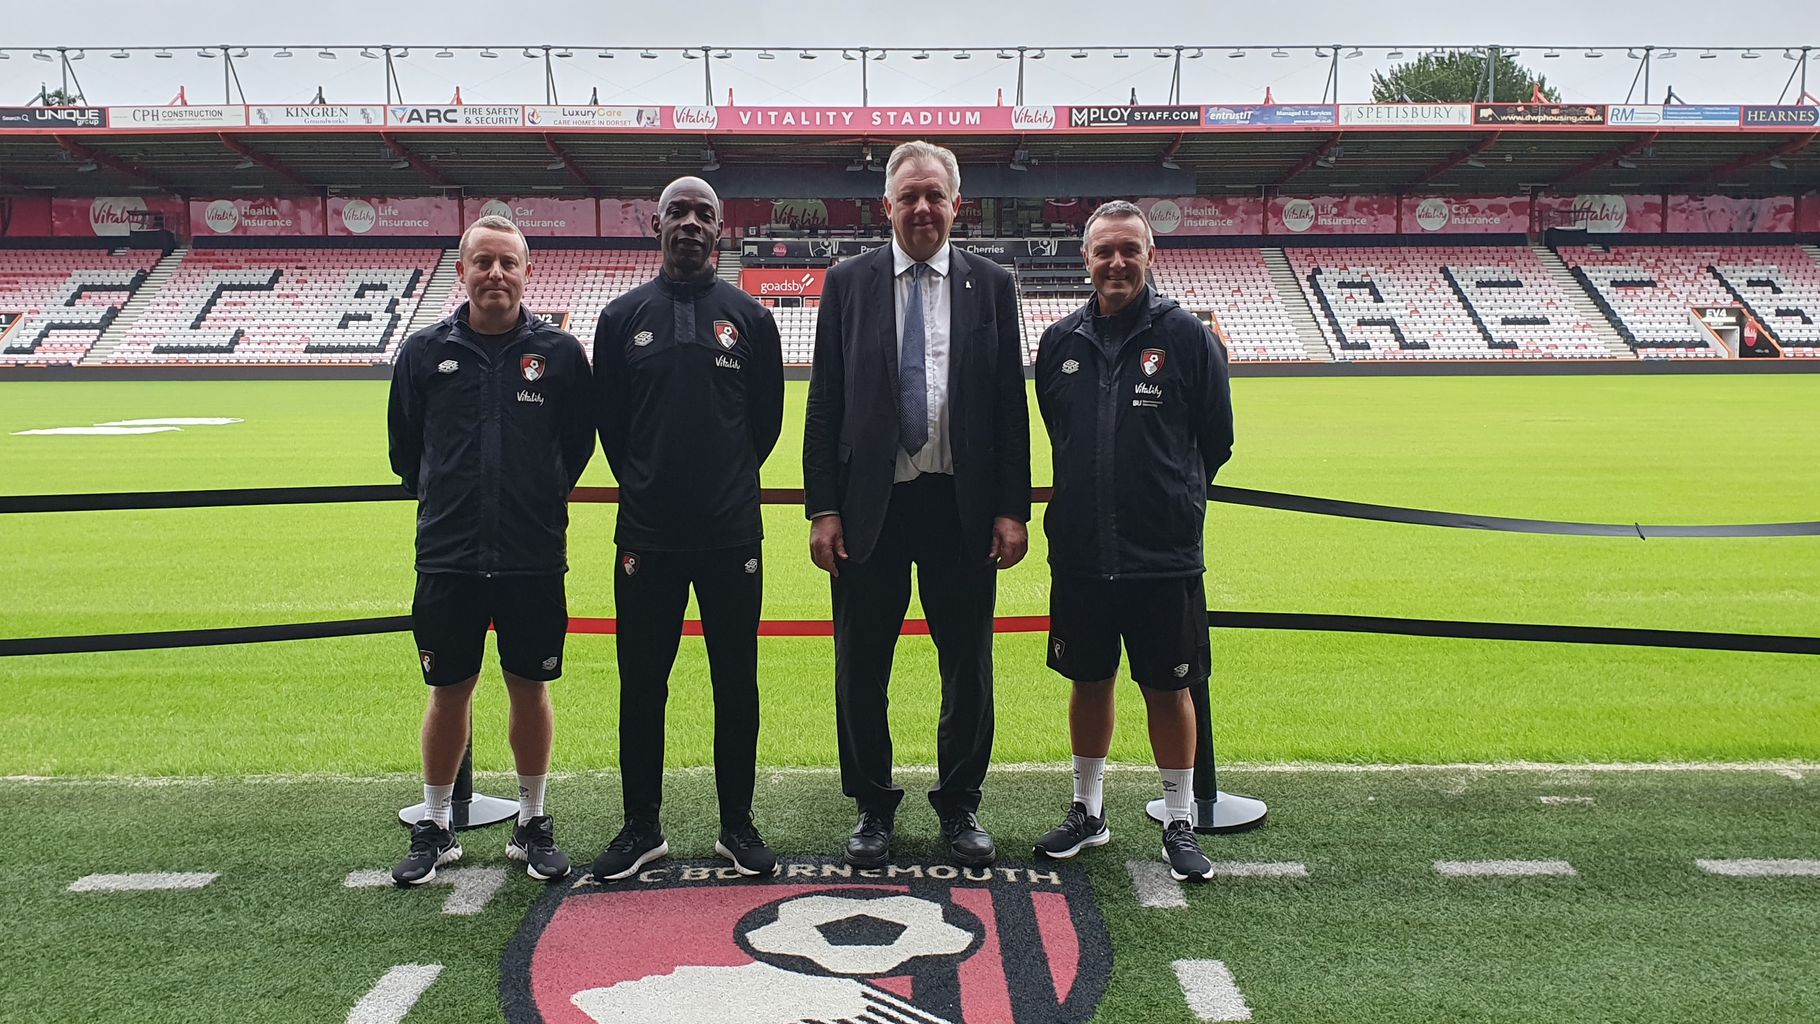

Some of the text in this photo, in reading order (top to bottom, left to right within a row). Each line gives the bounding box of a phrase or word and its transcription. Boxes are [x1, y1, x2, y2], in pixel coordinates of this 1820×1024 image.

[35, 109, 100, 121] UNIQUE
[132, 109, 224, 122] CPH CONSTRUCTION
[285, 106, 349, 118] KINGREN
[406, 108, 458, 124] ARC
[463, 107, 520, 116] FIRE SAFETY
[675, 106, 717, 127] Vitality
[1013, 106, 1054, 126] Vitality
[1134, 111, 1199, 120] STAFF.COM
[1357, 106, 1453, 119] SPETISBURY
[1610, 107, 1635, 121] RM
[1747, 110, 1815, 122] HEARNES
[475, 116, 519, 125] SECURITY
[553, 119, 573, 127] CARE
[739, 111, 981, 125] VITALITY STADIUM
[1501, 114, 1603, 123] www.dwphousing.co.uk
[241, 205, 277, 216] Health
[378, 206, 399, 217] Life
[515, 207, 535, 217] Car
[1150, 207, 1180, 222] Vitality
[1183, 206, 1220, 217] Health
[1283, 206, 1316, 222] Vitality
[1318, 205, 1339, 215] Life
[1451, 204, 1471, 214] Car
[206, 207, 240, 223] Vitality
[343, 207, 376, 224] Vitality
[1451, 215, 1501, 226] insurance
[241, 217, 293, 227] insurance
[378, 217, 430, 228] insurance
[515, 218, 566, 228] insurance
[1183, 217, 1234, 228] insurance
[1317, 216, 1368, 226] insurance
[966, 245, 1005, 255] Cherries
[760, 279, 806, 295] goadsby
[715, 355, 741, 372] Vitality
[1134, 381, 1163, 399] Vitality
[516, 389, 545, 406] Vitality
